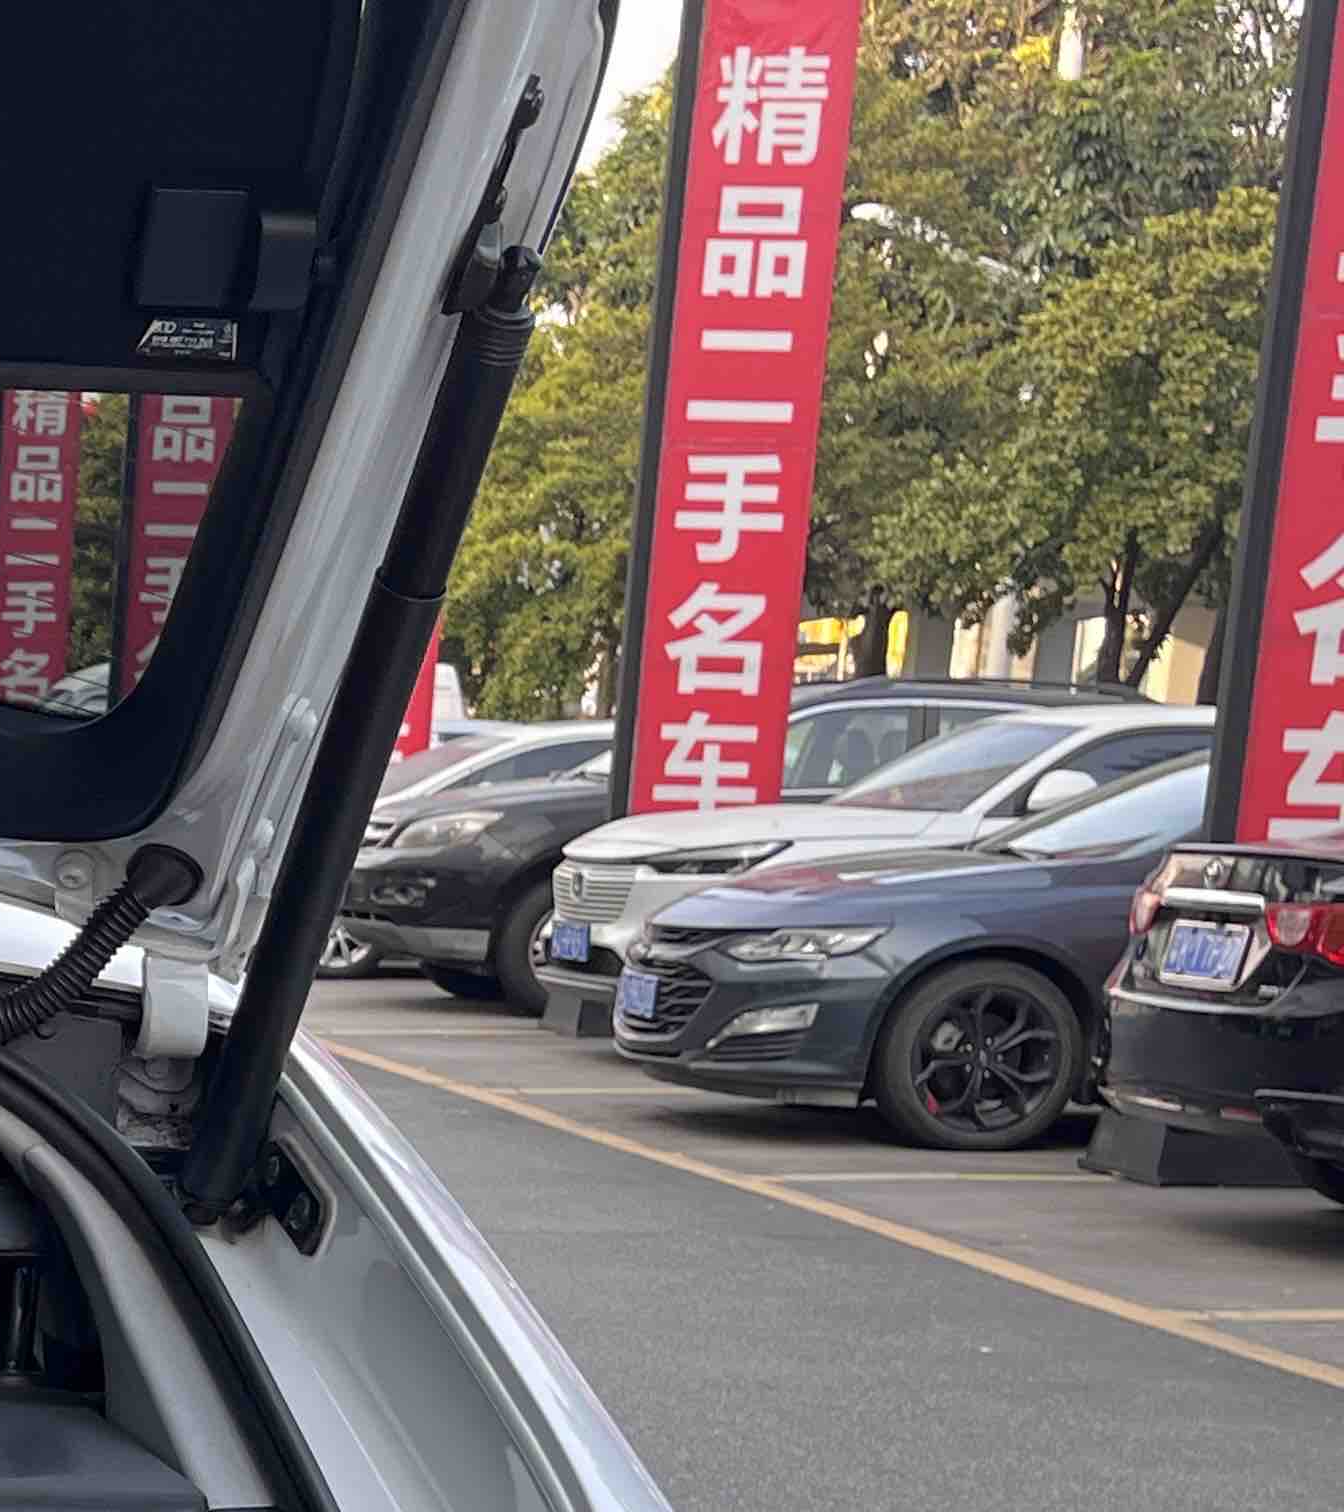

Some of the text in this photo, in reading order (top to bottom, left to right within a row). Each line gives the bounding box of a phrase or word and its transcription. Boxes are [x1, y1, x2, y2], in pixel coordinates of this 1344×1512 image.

[133, 396, 216, 690] 品二手
[652, 45, 831, 808] 精品二手名车
